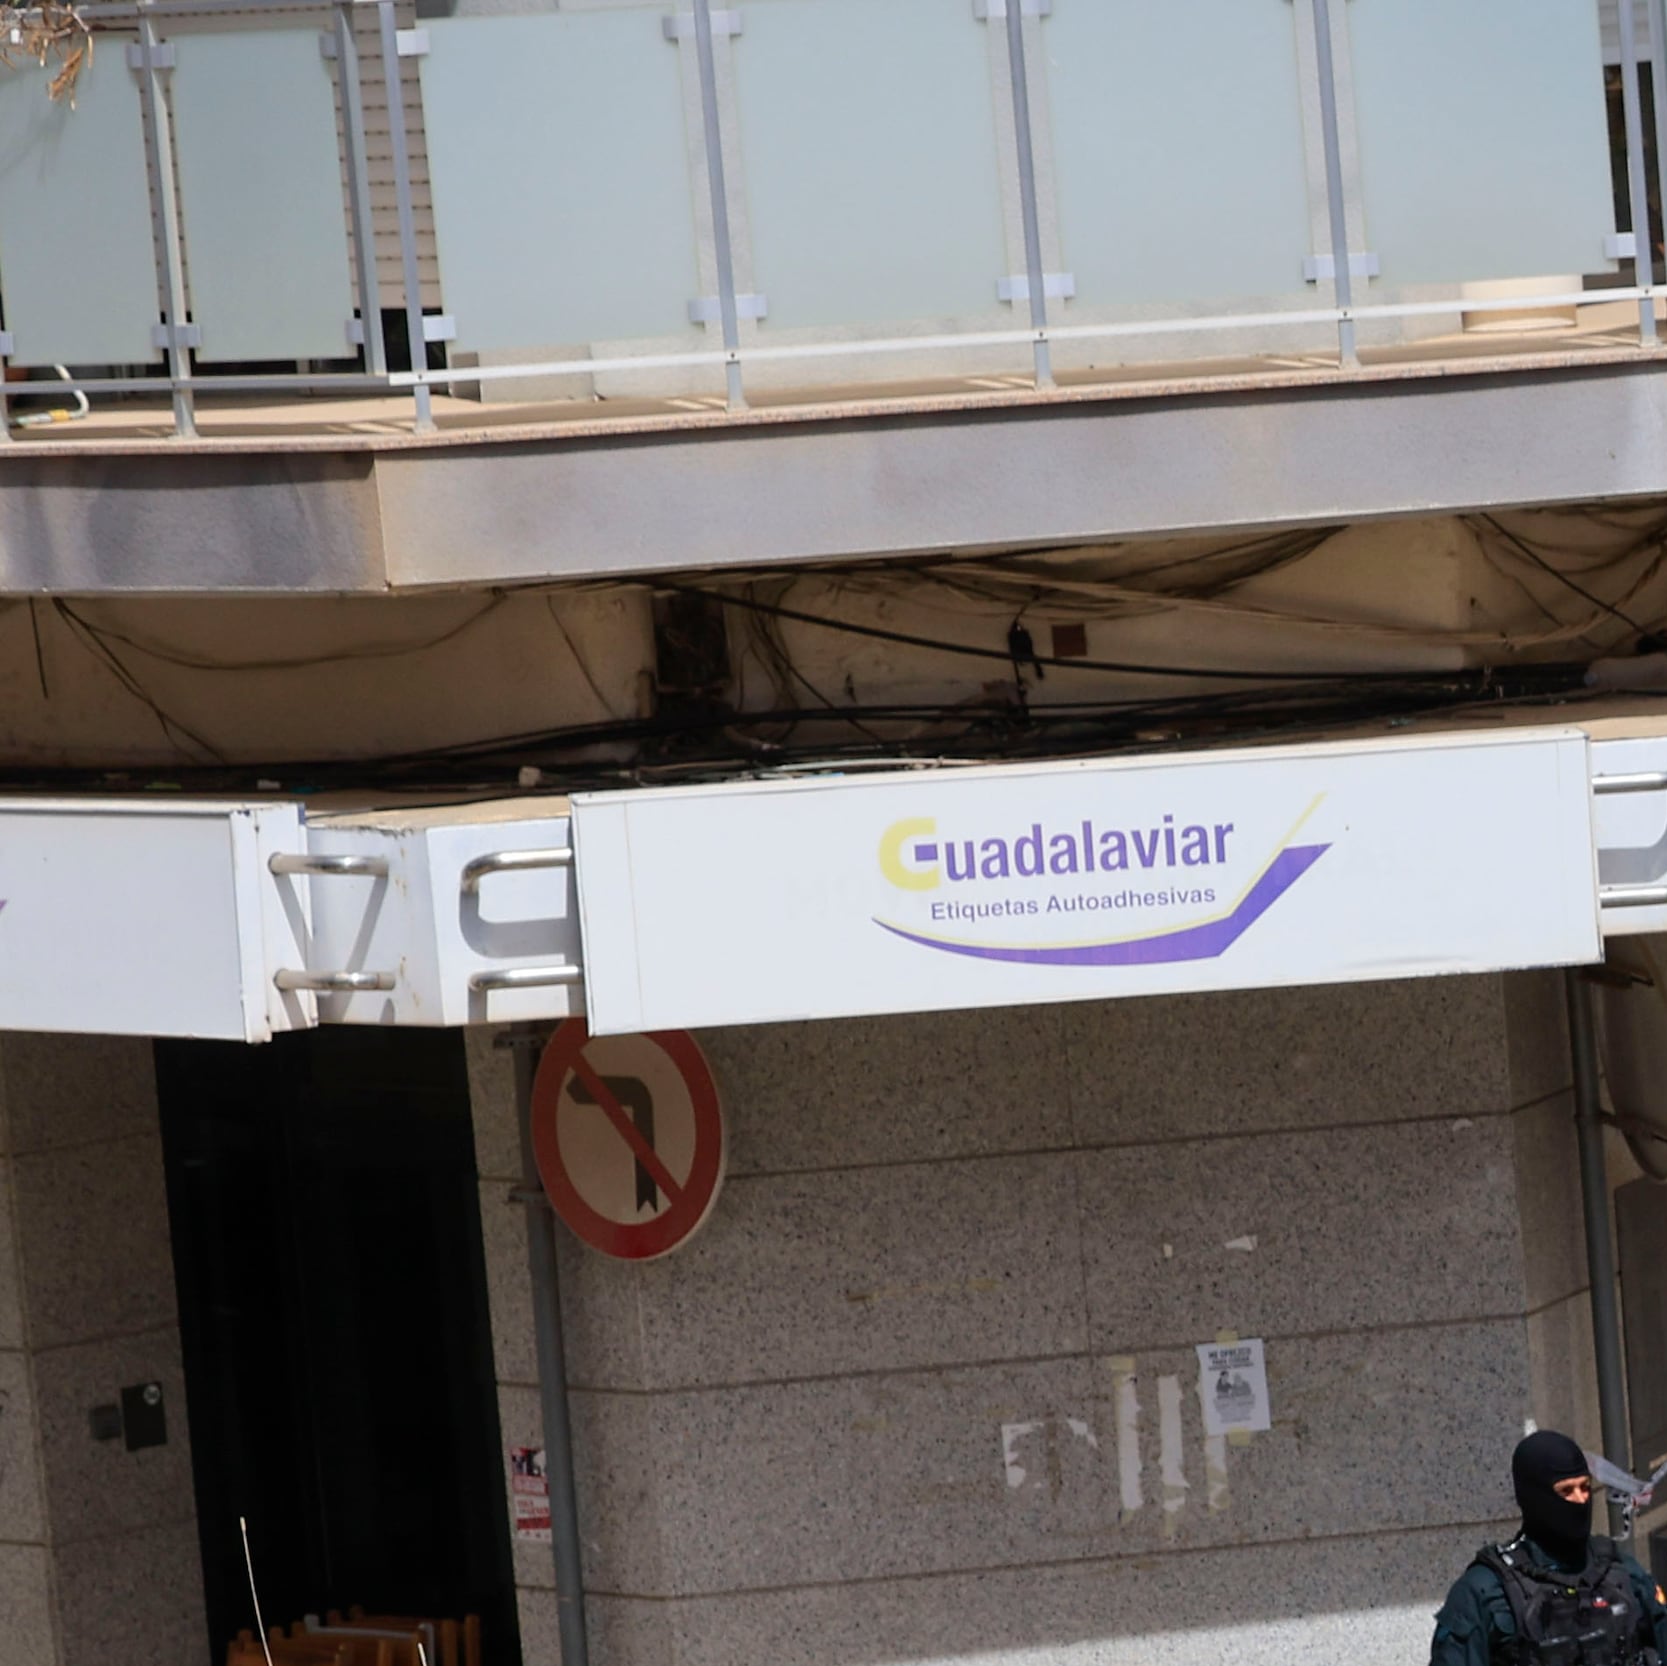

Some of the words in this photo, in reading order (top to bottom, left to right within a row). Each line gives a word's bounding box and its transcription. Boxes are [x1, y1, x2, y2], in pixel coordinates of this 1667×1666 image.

[878, 814, 1235, 892] Guadalaviar
[930, 898, 1039, 923] Etiquetas
[1046, 887, 1217, 914] Autoadhesivas
